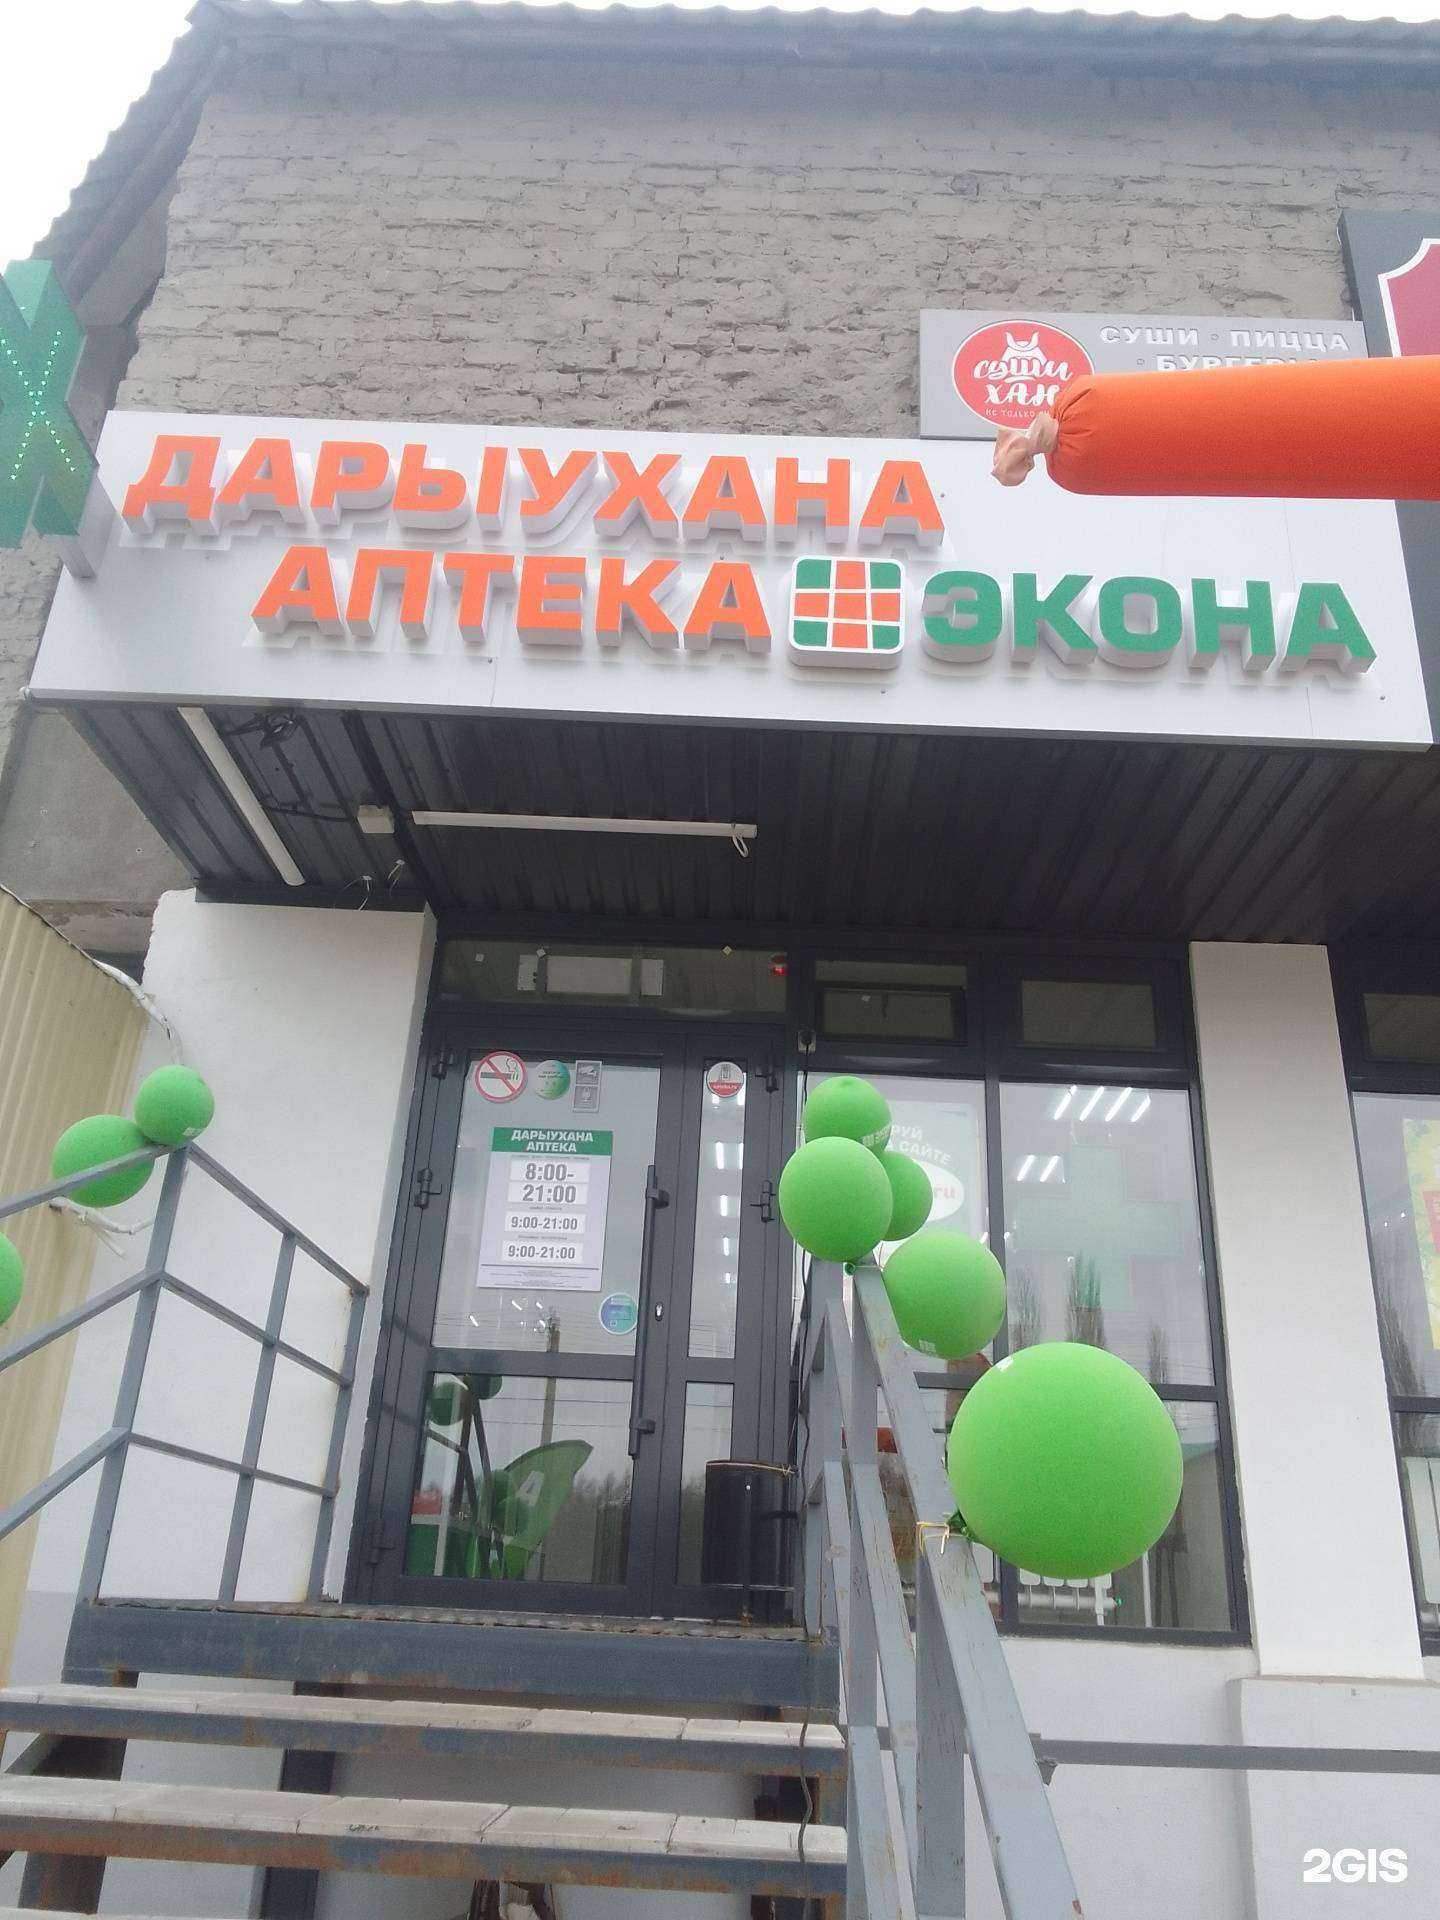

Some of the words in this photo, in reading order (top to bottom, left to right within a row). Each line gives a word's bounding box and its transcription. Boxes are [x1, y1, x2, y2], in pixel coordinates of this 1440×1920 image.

[1100, 325, 1199, 346] СУШИ
[1229, 329, 1349, 352] ПИЦЦА
[121, 434, 946, 540] ДАРЫУХАНА
[250, 545, 773, 650] АПТЕКА
[921, 569, 1378, 672] ЭКОНА
[511, 1129, 594, 1142] ДАРЫУХАНА
[526, 1141, 577, 1153] АПТЕКА
[522, 1184, 577, 1203] 21:00
[511, 1216, 578, 1230] 9:00-21:00
[508, 1245, 576, 1259] 9:00-21:00
